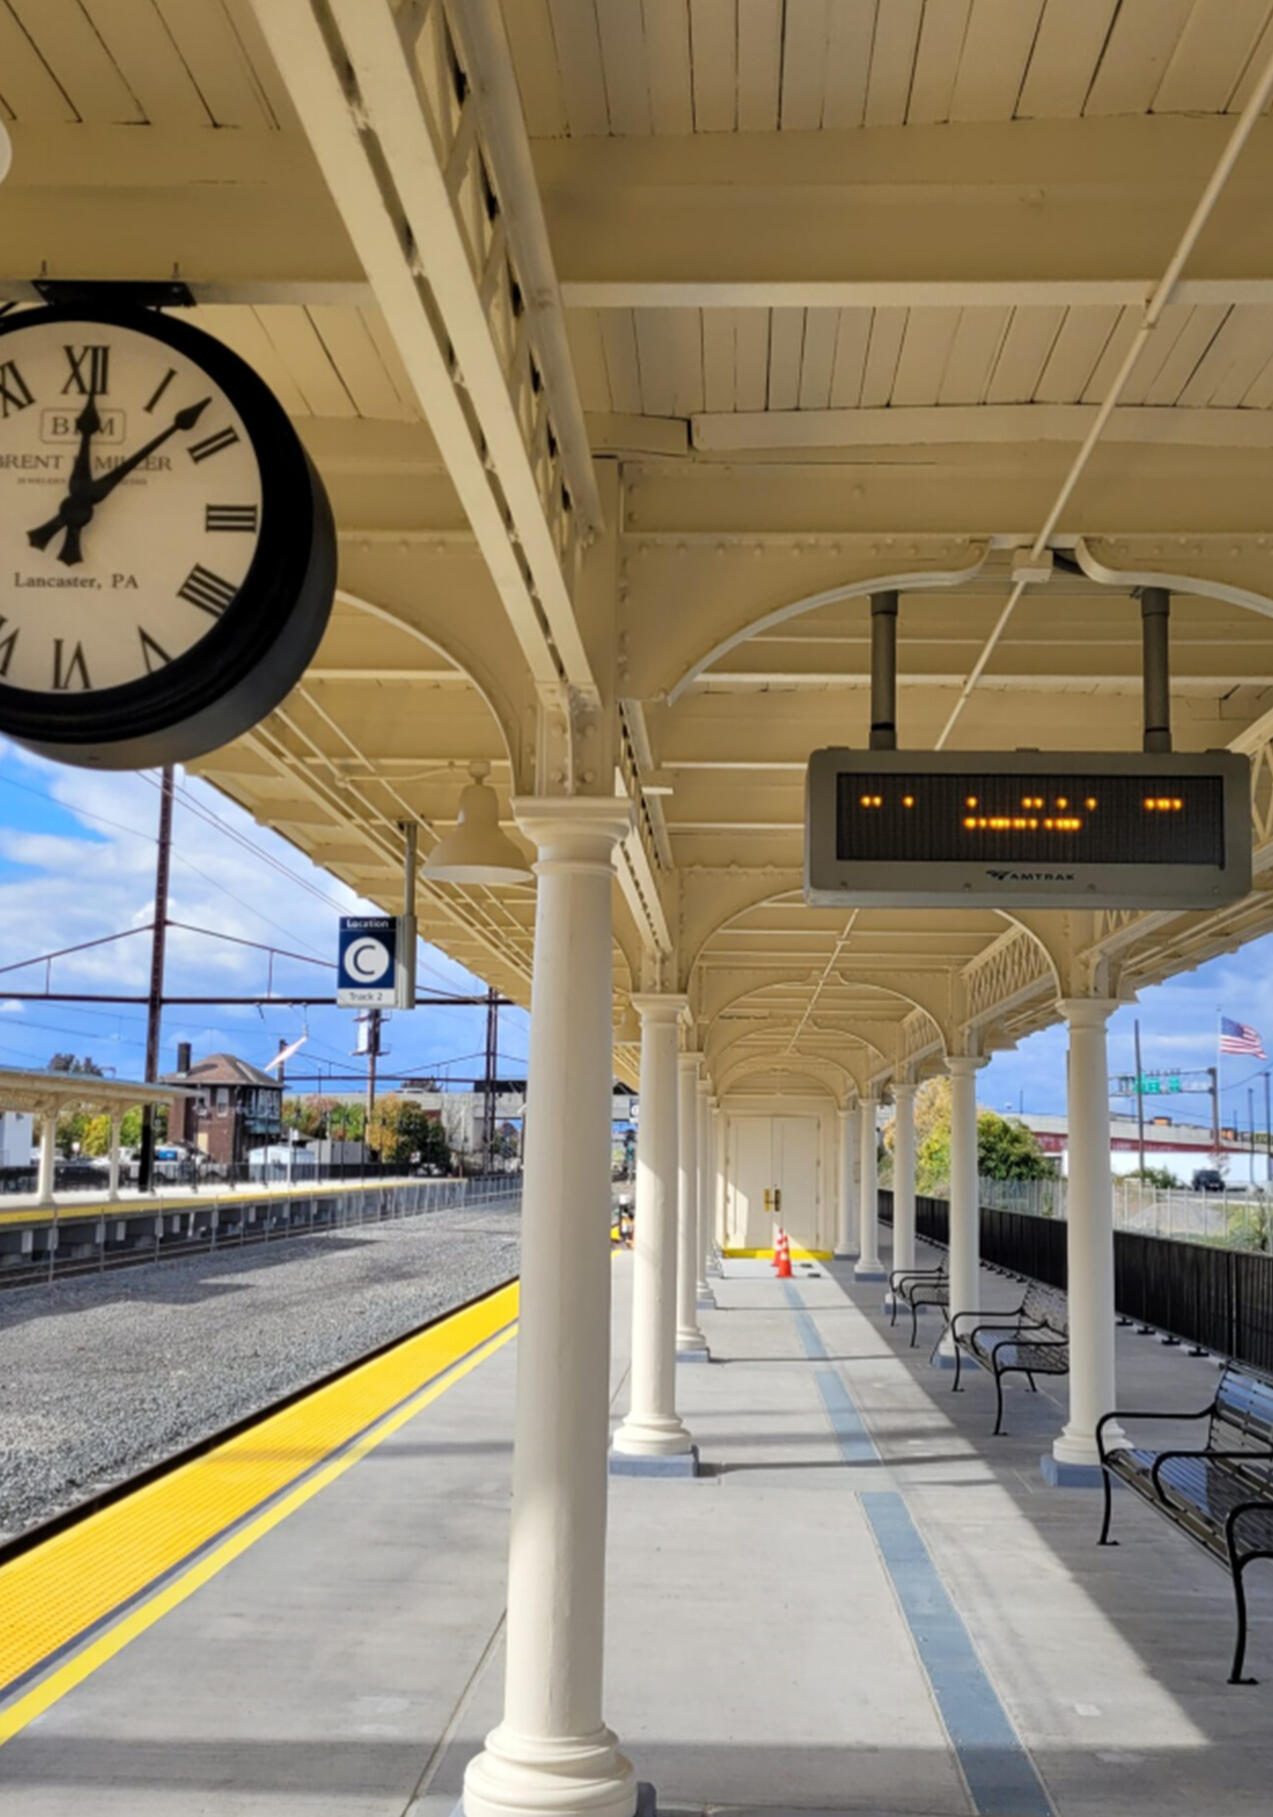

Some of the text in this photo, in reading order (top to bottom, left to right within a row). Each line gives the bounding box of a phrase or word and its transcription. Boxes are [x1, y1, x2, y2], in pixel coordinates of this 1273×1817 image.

[60, 344, 111, 395] XII
[143, 367, 177, 414] I
[51, 416, 115, 437] BM
[187, 425, 240, 464] II
[94, 456, 173, 472] MIER
[205, 503, 258, 533] III
[14, 572, 139, 590] Lancaster, PA
[1010, 873, 1075, 881] AMTRAK
[346, 919, 389, 929] Location
[353, 944, 376, 975] C
[350, 991, 383, 1001] Track 2
